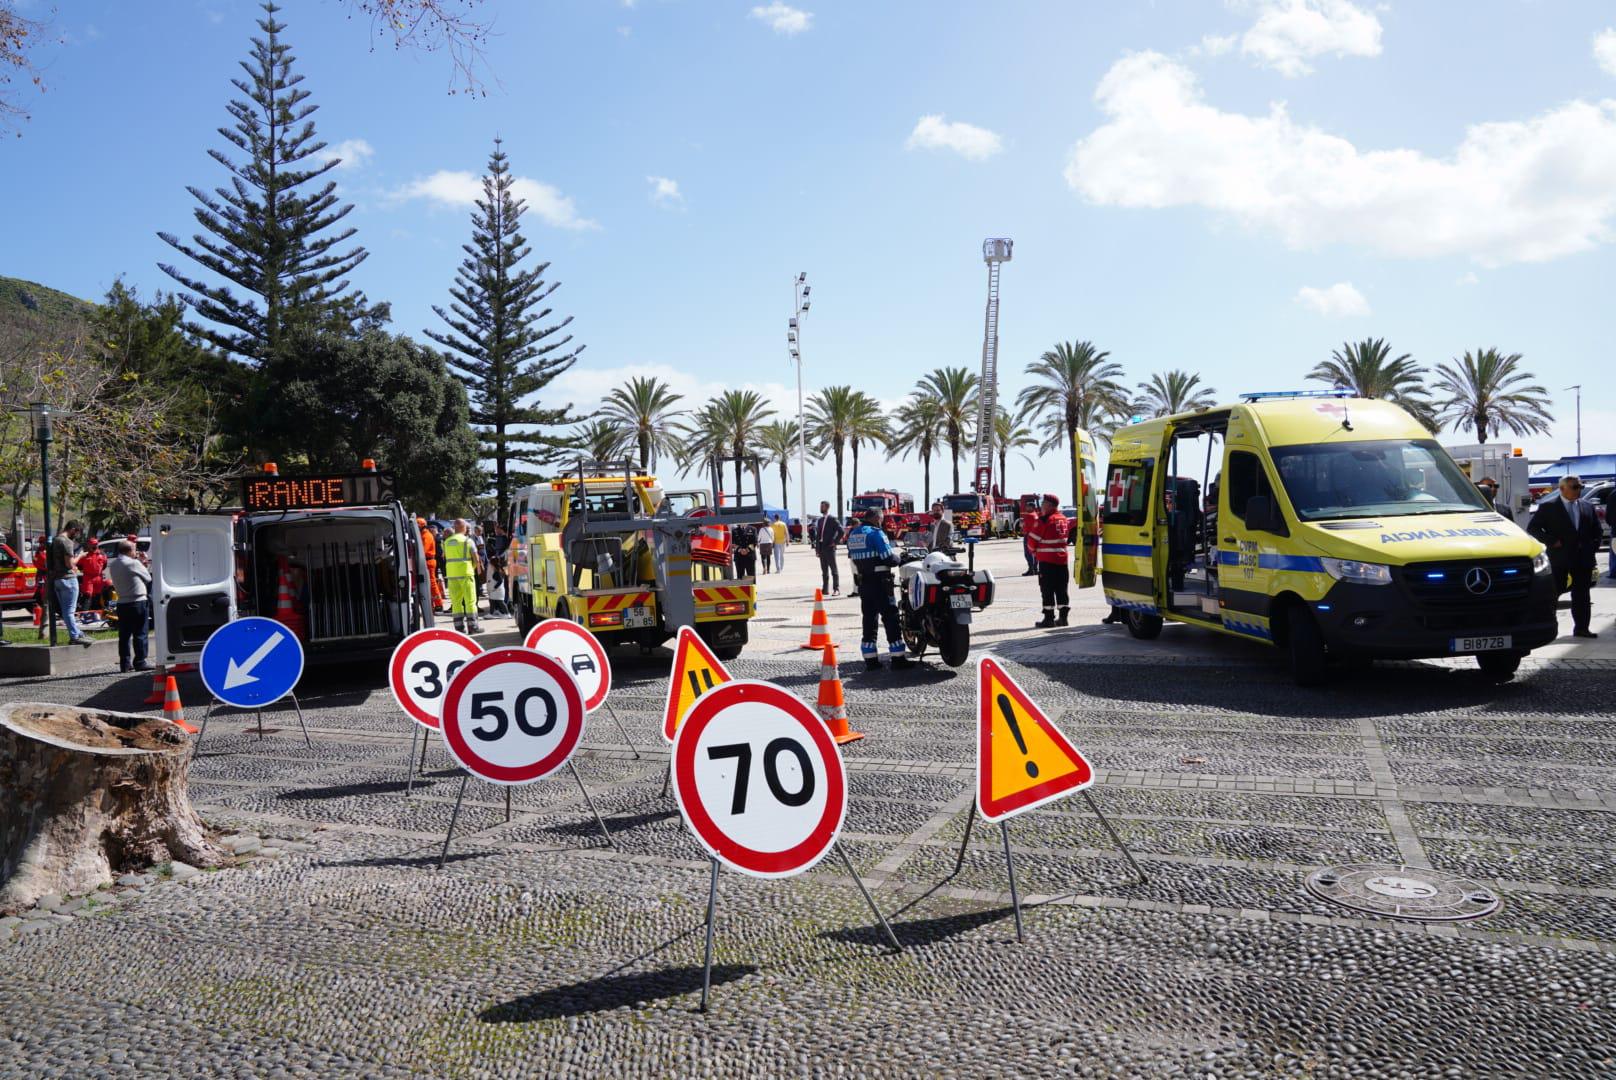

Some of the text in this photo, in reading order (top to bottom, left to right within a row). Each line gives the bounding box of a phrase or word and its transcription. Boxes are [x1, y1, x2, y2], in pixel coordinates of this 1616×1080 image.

[249, 479, 344, 506] RANDE
[471, 687, 557, 741] 50
[707, 737, 815, 815] 70
